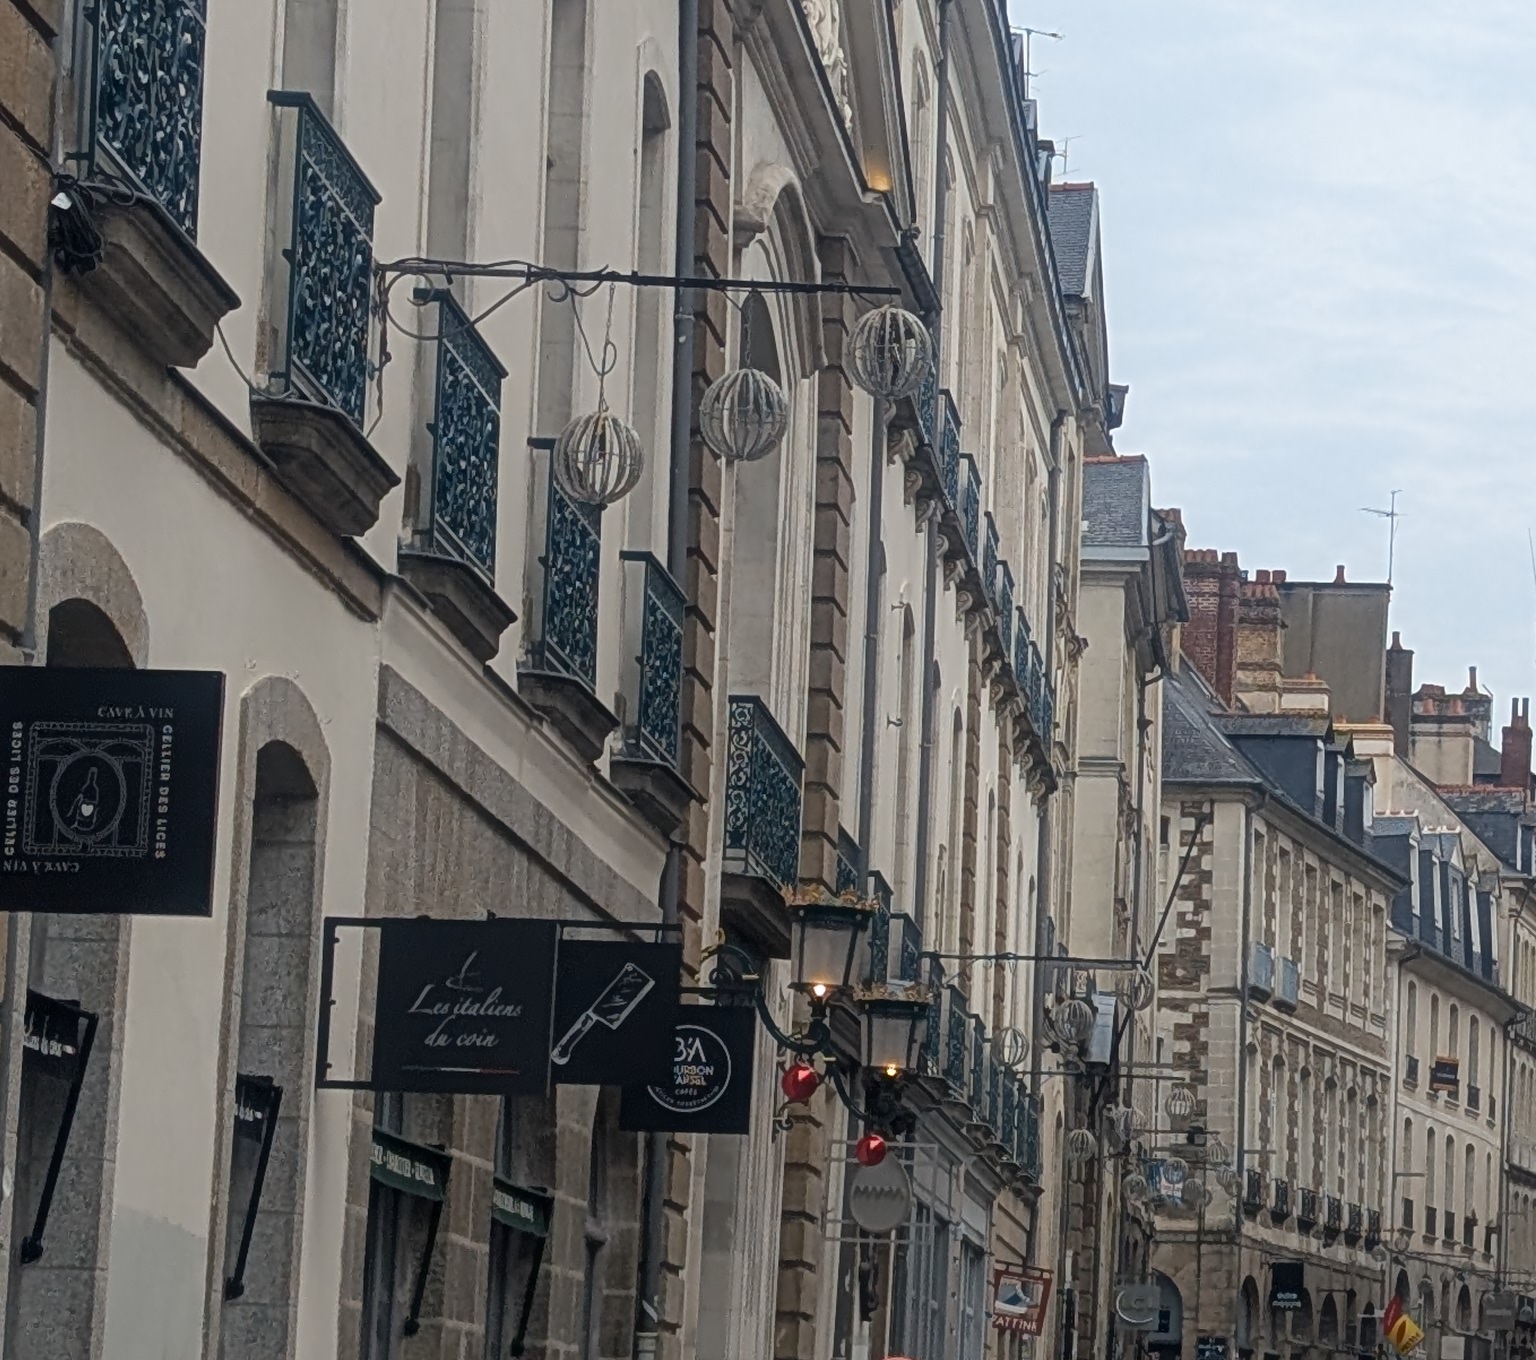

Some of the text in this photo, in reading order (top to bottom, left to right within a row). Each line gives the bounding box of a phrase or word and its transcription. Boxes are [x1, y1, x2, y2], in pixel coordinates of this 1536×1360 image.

[149, 707, 174, 719] VIN
[11, 721, 24, 762] LICES
[8, 766, 20, 794] DES
[157, 786, 170, 814] DES
[154, 818, 168, 859] LICES
[407, 983, 523, 1017] Les italiens
[423, 1013, 500, 1048] du coin
